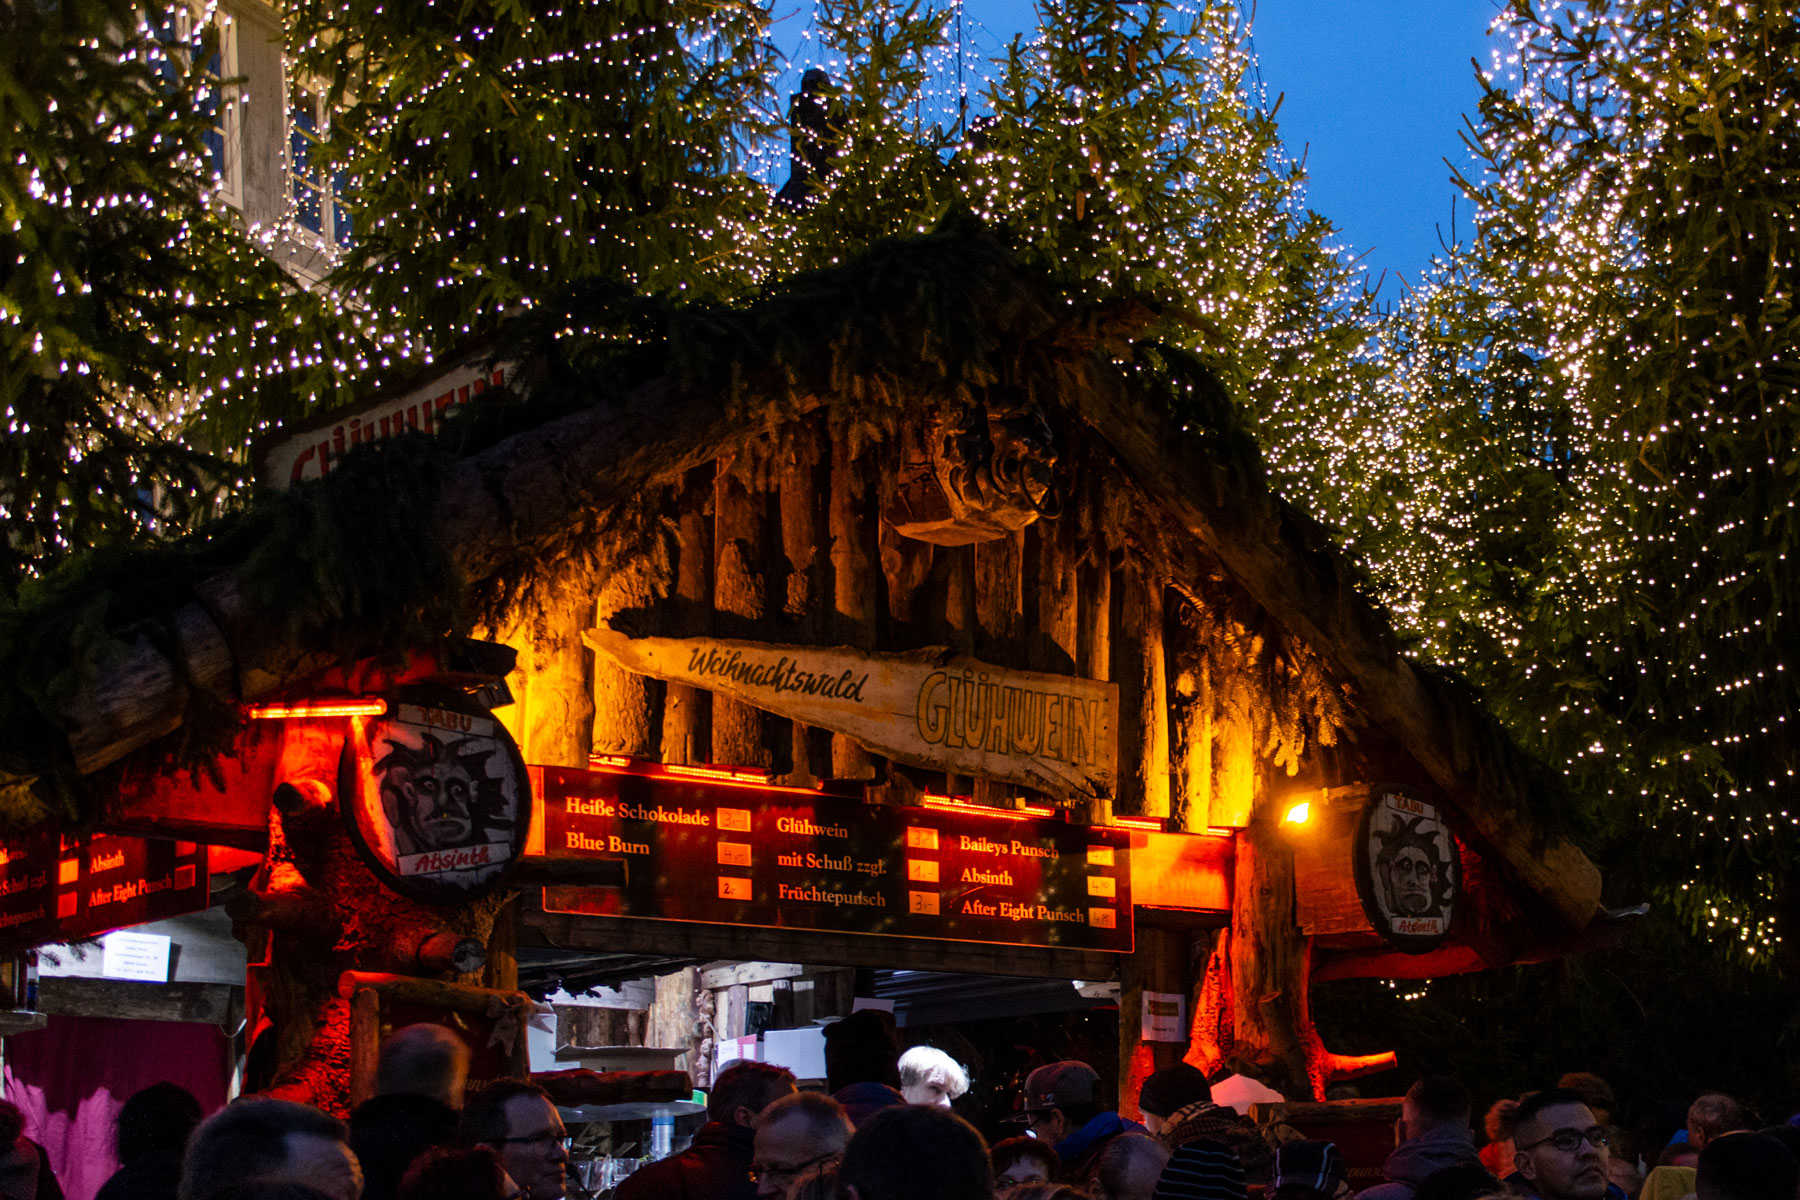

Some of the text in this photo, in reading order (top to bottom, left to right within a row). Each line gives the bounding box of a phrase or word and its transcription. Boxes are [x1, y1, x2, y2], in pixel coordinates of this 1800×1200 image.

[688, 647, 869, 702] Weihnachtswald
[416, 706, 473, 732] TABU
[916, 669, 1100, 766] GLÜHWEIN
[565, 796, 710, 827] Heiße Schokolade
[1393, 795, 1425, 815] TABU
[776, 817, 849, 838] Glühwein
[566, 832, 650, 855] Blue Burn
[959, 835, 1060, 859] Baileys Punsch
[90, 850, 125, 874] Absinth
[416, 846, 492, 872] Absinth
[777, 851, 887, 877] mit Schuß zzgl.
[960, 867, 1013, 886] Absinth
[88, 888, 112, 908] After
[113, 881, 137, 903] Eight
[777, 883, 887, 907] Früchtepunsch
[961, 899, 1085, 923] After Eight Punsch
